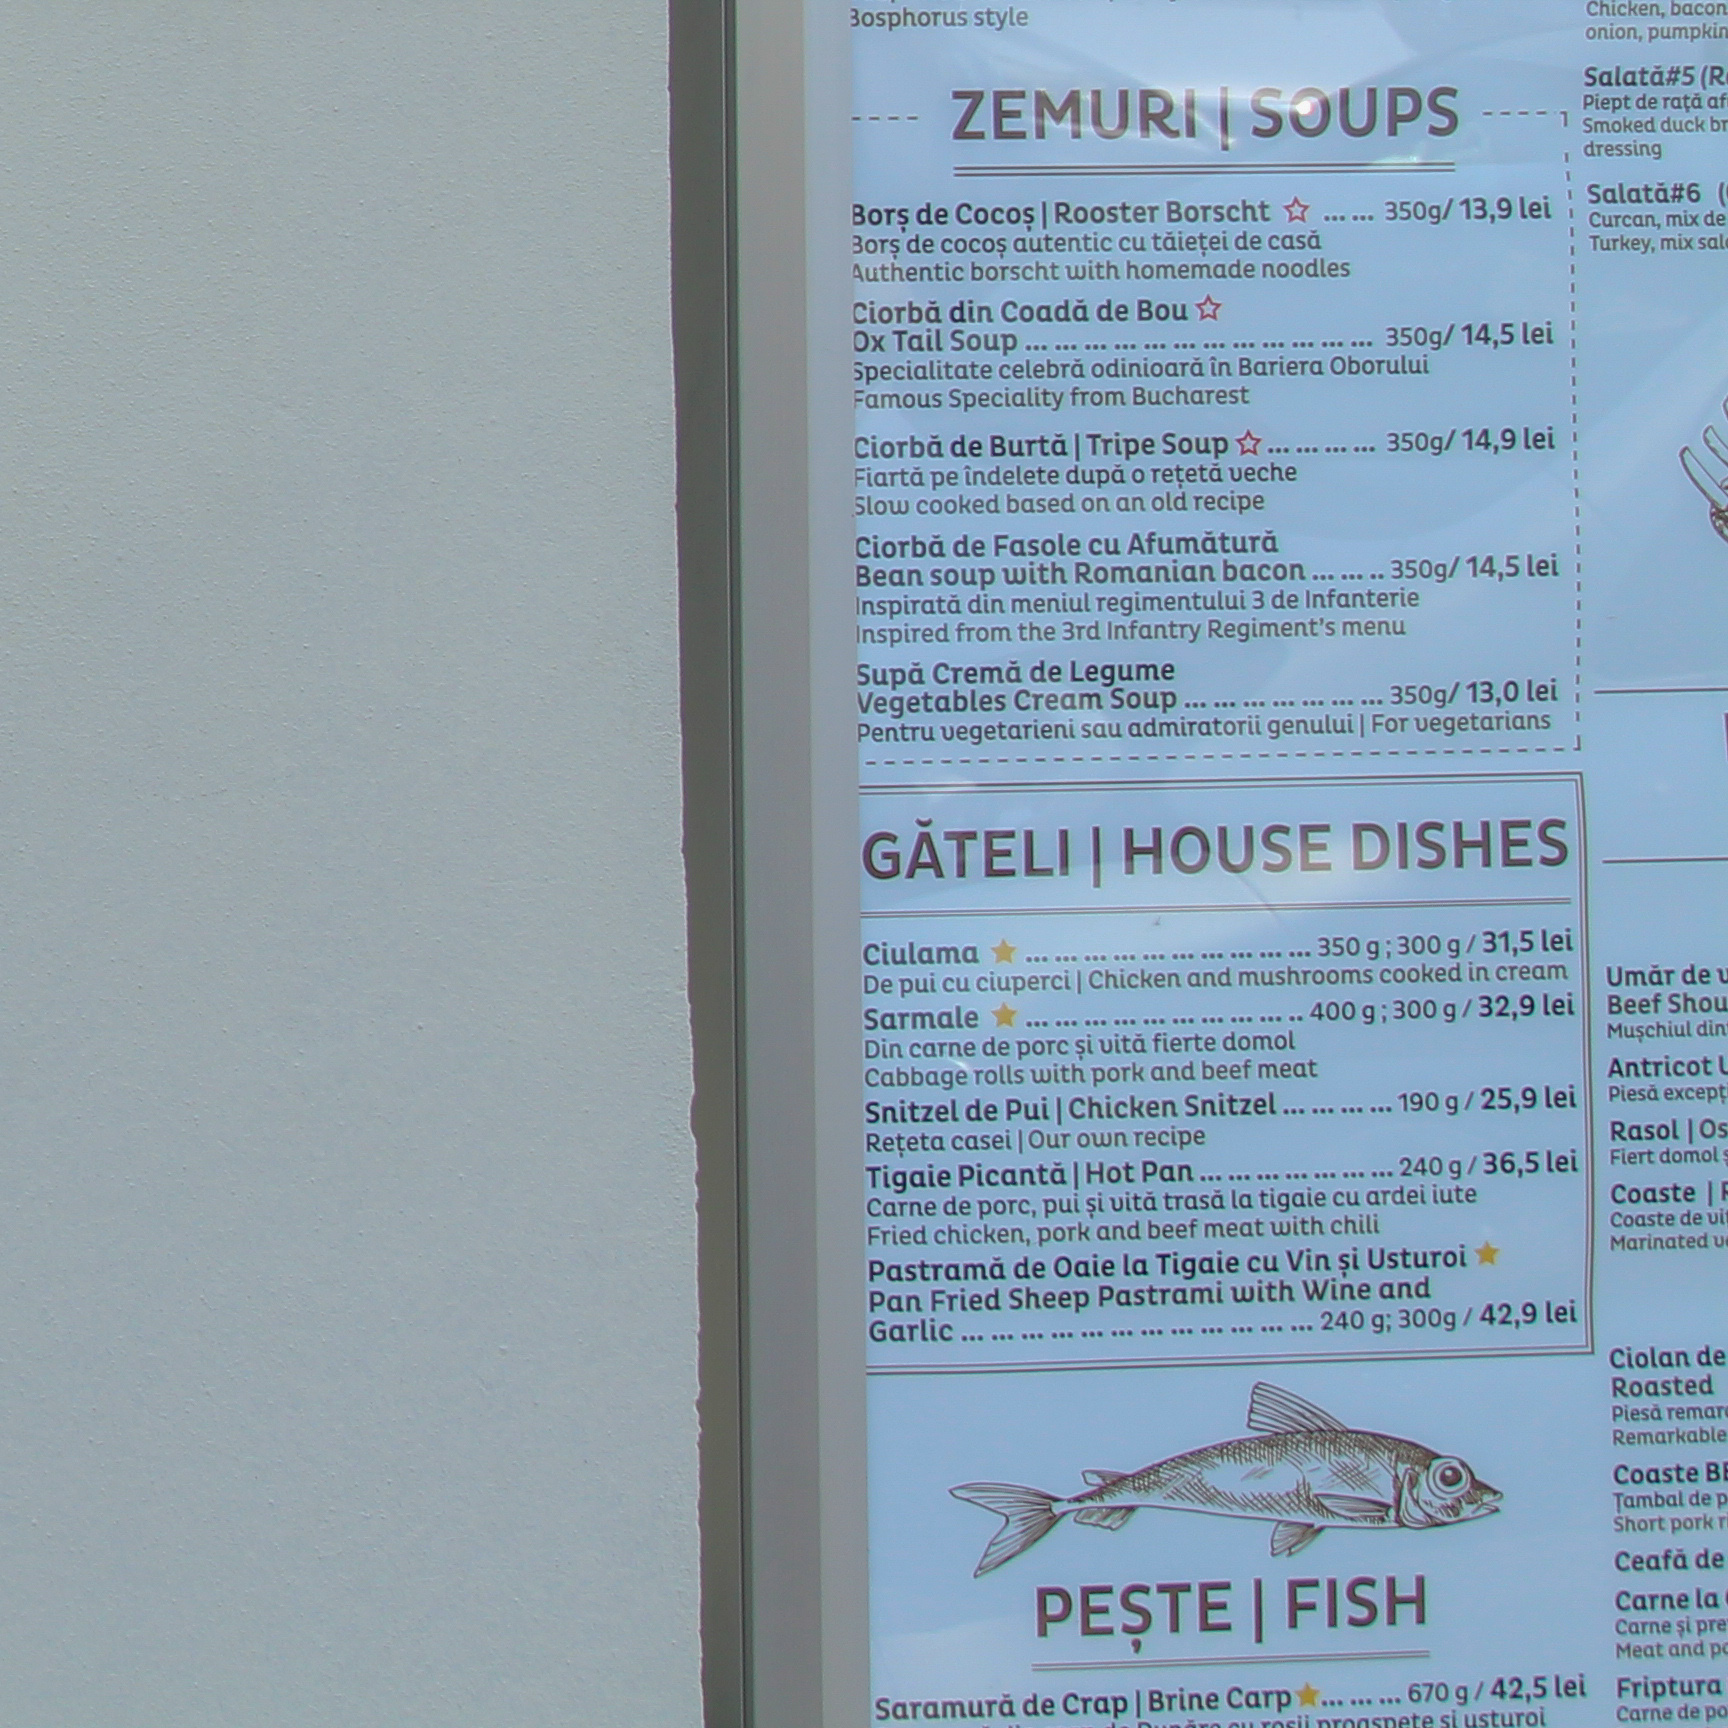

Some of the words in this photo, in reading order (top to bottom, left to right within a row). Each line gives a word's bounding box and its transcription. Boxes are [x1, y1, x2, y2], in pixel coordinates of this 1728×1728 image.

[952, 89, 1196, 140] ZEMURI
[1252, 87, 1458, 138] SOUPS
[1584, 140, 1662, 160] dressing
[915, 201, 949, 226] de
[1054, 201, 1160, 225] Rooster
[1166, 198, 1272, 224] Borscht
[1458, 196, 1514, 225] 13,9
[1518, 195, 1553, 220] lei
[891, 328, 944, 353] Tail
[949, 328, 1019, 357] Soup
[1460, 322, 1515, 351] 14,5
[1522, 321, 1555, 346] lei
[949, 433, 984, 458] de
[1085, 433, 1156, 462] Tripe
[1161, 432, 1230, 460] Soup
[1461, 427, 1517, 456] 14,9
[1523, 426, 1556, 451] lei
[855, 564, 925, 588] Bean
[929, 567, 996, 592] soup
[1001, 561, 1069, 586] with
[1074, 561, 1217, 585] Romanian
[1222, 558, 1307, 583] bacon
[1465, 554, 1521, 583] 14,5
[1526, 553, 1560, 578] lei
[1029, 659, 1063, 684] de
[1069, 659, 1176, 688] Legume
[857, 689, 1007, 720] Vegetables
[1013, 688, 1104, 712] Cream
[1110, 687, 1178, 715] Soup
[1465, 679, 1520, 708] 13,0
[1526, 678, 1559, 703] lei
[863, 818, 1069, 880] GĂTELI
[1124, 824, 1331, 875] HOUSE
[1352, 819, 1568, 870] DISHES
[863, 974, 894, 995] De
[898, 977, 938, 999] pui
[941, 976, 971, 993] cu
[975, 974, 1072, 997] ciuperci
[1088, 968, 1183, 990] Chicken
[1186, 966, 1233, 988] and
[1238, 965, 1374, 987] mushrooms
[1379, 961, 1464, 985] cooked
[1468, 965, 1491, 983] in
[1495, 964, 1569, 982] cream
[1608, 993, 1662, 1015] Beef
[864, 1065, 968, 1092] Cabbage
[972, 1064, 1025, 1086] rolls
[1029, 1062, 1087, 1085] with
[1090, 1061, 1145, 1088] pork
[1150, 1060, 1197, 1082] and
[1201, 1058, 1253, 1081] beef
[1257, 1058, 1319, 1080] meat
[1608, 1055, 1713, 1078] Antricot
[1610, 1119, 1679, 1142] Rasol
[1611, 1183, 1696, 1204] Coaste
[1611, 1233, 1709, 1251] Marinated
[1012, 1255, 1047, 1280] de
[1053, 1255, 1116, 1279] Oaie
[1122, 1252, 1150, 1277] la
[1154, 1252, 1241, 1281] Tigaie
[1246, 1254, 1280, 1274] cu
[1285, 1249, 1332, 1273] Vin
[1367, 1247, 1468, 1271] Usturoi
[869, 1290, 924, 1313] Pan
[930, 1286, 1003, 1313] Fried
[1008, 1286, 1091, 1315] Sheep
[1098, 1284, 1225, 1308] Pastrami
[1229, 1278, 1296, 1304] with
[1302, 1278, 1372, 1302] Wine
[1378, 1275, 1432, 1301] and
[1609, 1346, 1691, 1369] Ciolan
[1697, 1345, 1726, 1367] de
[1612, 1374, 1714, 1398] Roasted
[1613, 1427, 1727, 1446] Remarkable
[1037, 1581, 1232, 1654] PEȘTE
[1287, 1575, 1426, 1629] FISH
[1022, 1692, 1056, 1718] de
[1061, 1691, 1129, 1721] Crap
[1148, 1686, 1220, 1713] Brine
[1225, 1686, 1293, 1714] Carp
[1407, 1681, 1450, 1704] 670
[1489, 1675, 1548, 1705] 42,5
[1554, 1672, 1588, 1699] lei
[1617, 1676, 1723, 1702] Friptura
